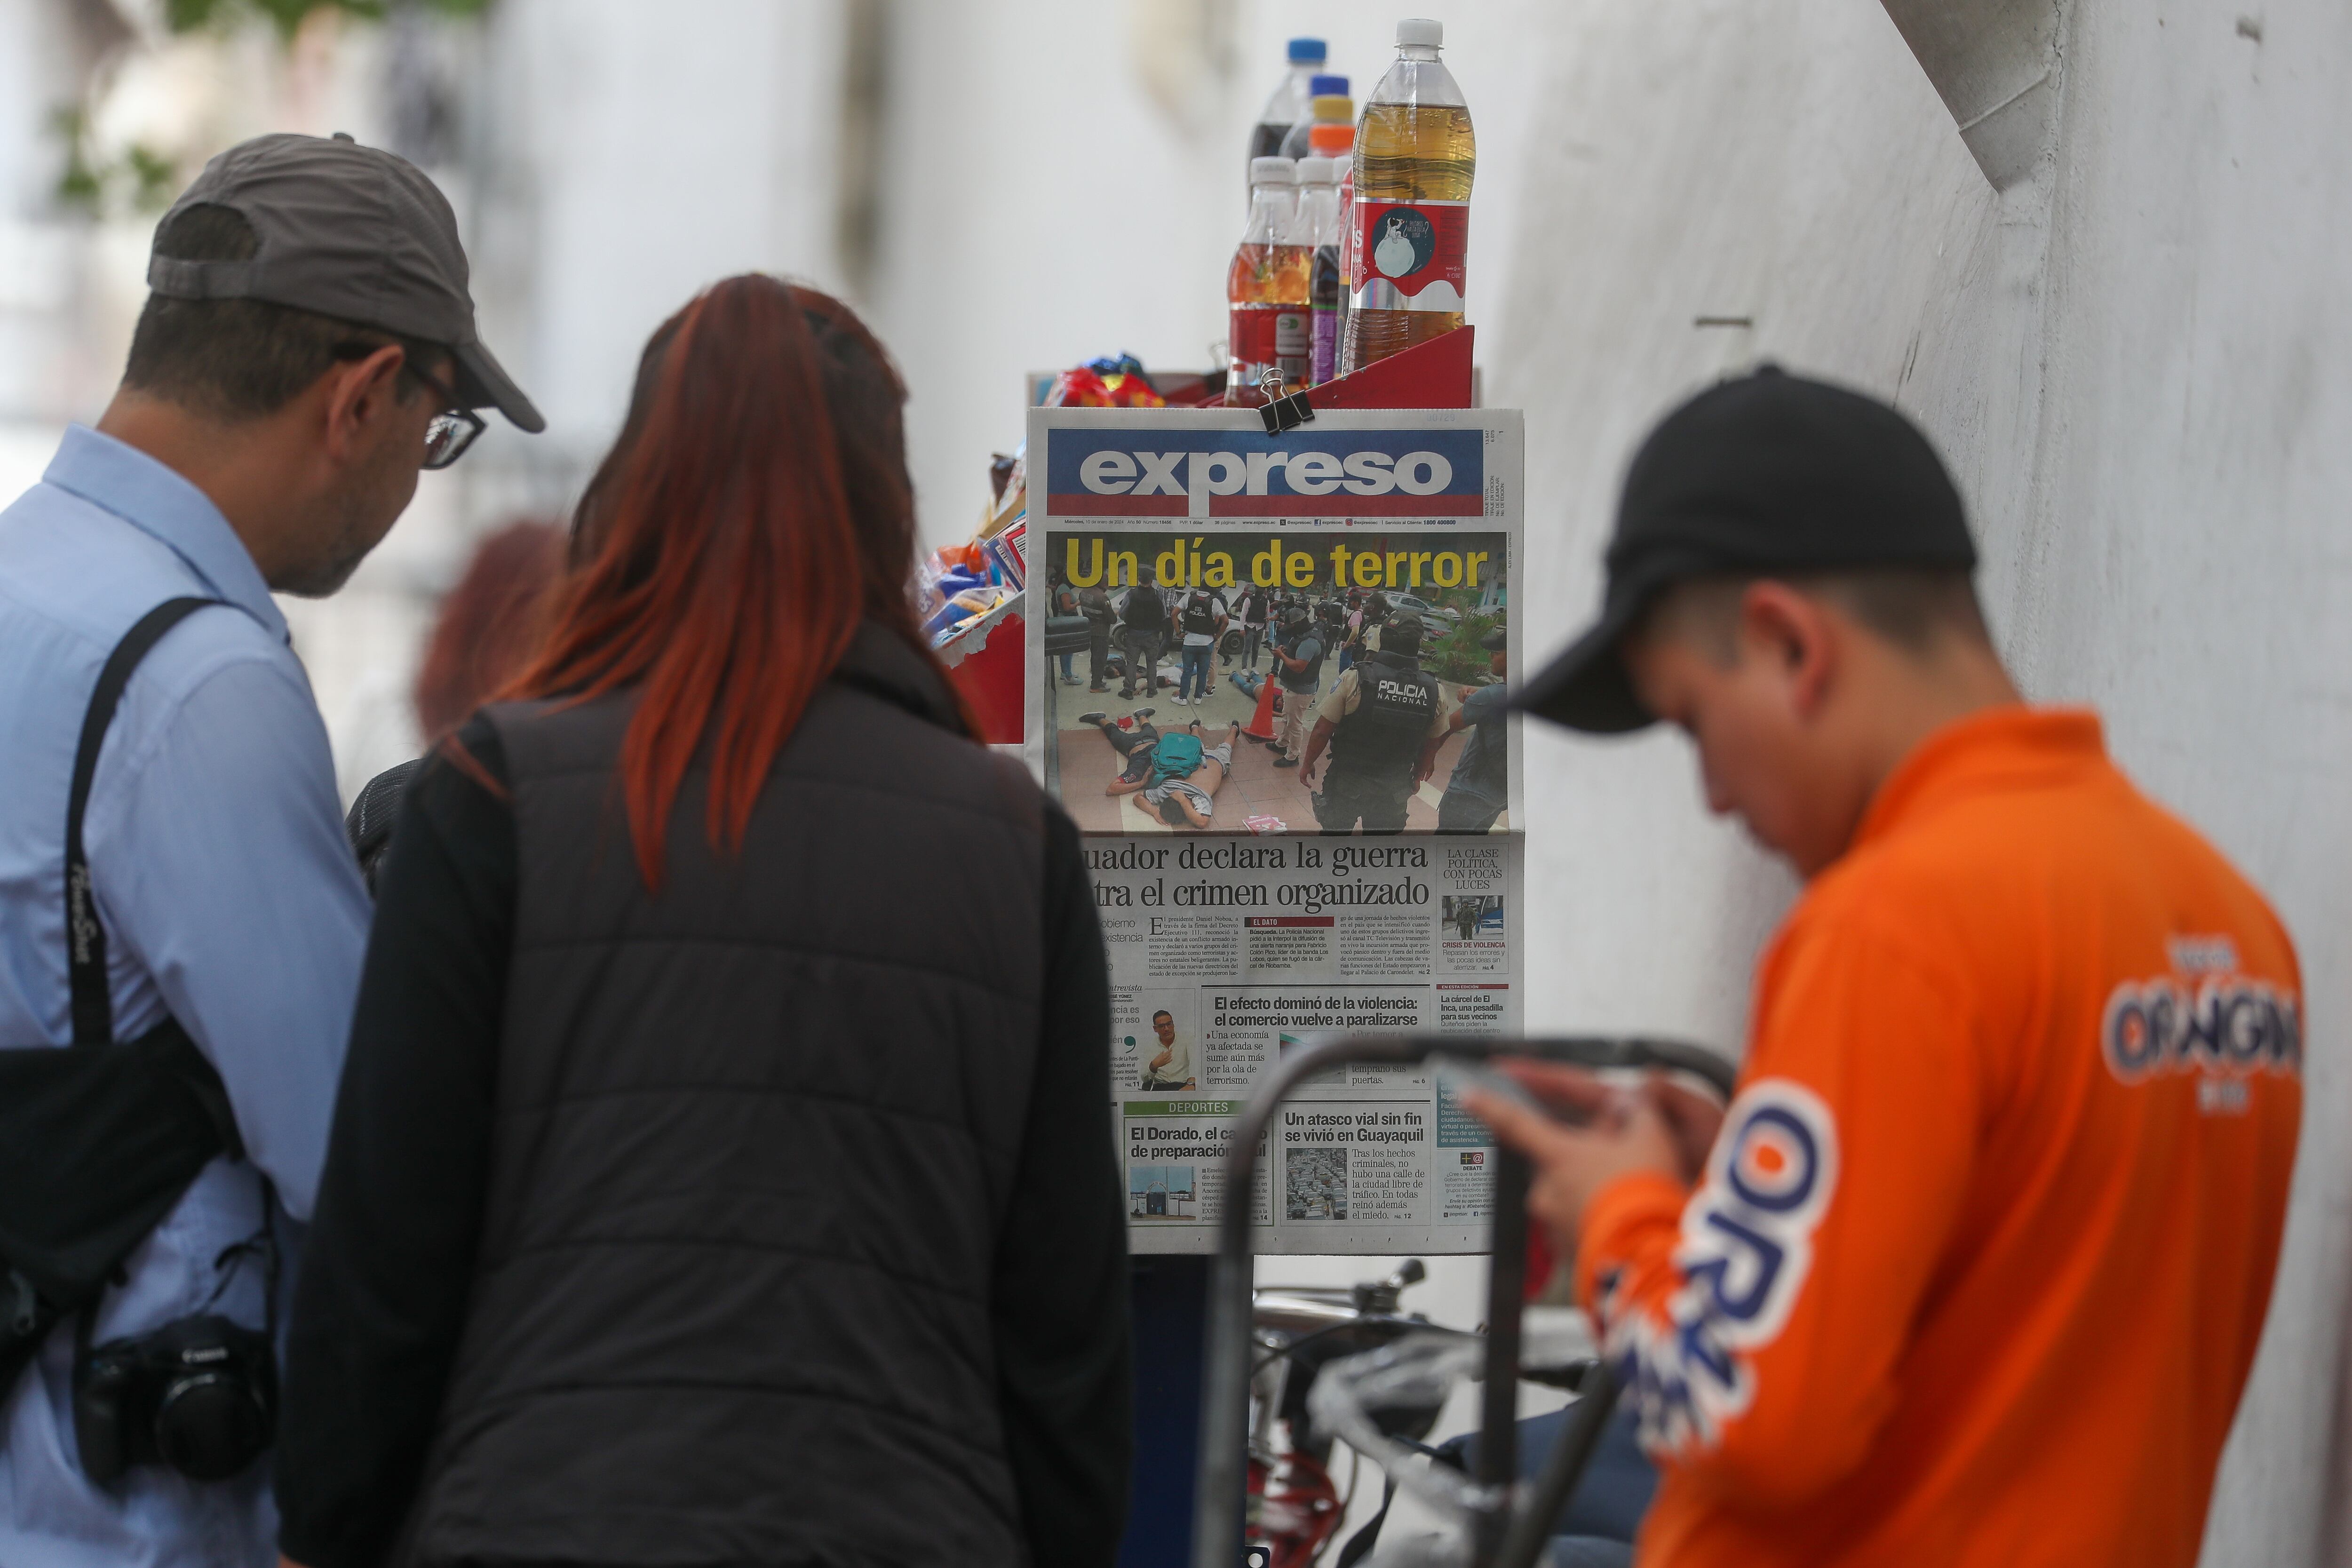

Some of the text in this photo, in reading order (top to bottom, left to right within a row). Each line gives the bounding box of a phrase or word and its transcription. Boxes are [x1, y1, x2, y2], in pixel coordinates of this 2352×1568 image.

[1080, 451, 1452, 516] expreso
[1066, 538, 1138, 588] Un
[1155, 537, 1236, 588] día
[1252, 539, 1314, 588] de
[1330, 544, 1488, 588] terror
[1378, 680, 1427, 700] POLICIA
[1377, 694, 1427, 706] NACIONAL
[1465, 849, 1499, 858] CLASE
[1083, 842, 1429, 877] uador declara la guerra
[1448, 856, 1498, 869] POLÍTICA,
[1443, 869, 1502, 879] CON POCAS
[1455, 880, 1490, 889] LUCES
[1095, 876, 1429, 914] tra el crimen organizado
[1101, 919, 1135, 928] obierno
[1215, 996, 1417, 1010] El efecto dominó de la violencia:
[1473, 1004, 1503, 1012] pesadilla
[1215, 1012, 1418, 1028] el comercio vuelve a paralizarse
[1211, 1030, 1269, 1039] Una economía
[1218, 1042, 1252, 1050] afectada
[1352, 1064, 1390, 1074] temprano
[1352, 1076, 1383, 1086] puertas.
[1169, 1102, 1228, 1112] DEPORTES
[1285, 1112, 1422, 1125] Un atasco vial sin fin
[1131, 1127, 1144, 1140] El
[1148, 1127, 1201, 1142] Dorado,
[1205, 1127, 1217, 1139] el
[1285, 1128, 1423, 1144] se vivió en Guayaquil
[1131, 1145, 1148, 1157] de
[1352, 1149, 1415, 1157] Tras los hechos
[1352, 1159, 1396, 1168] criminales,
[1352, 1170, 1373, 1178] hubo
[1362, 1180, 1390, 1188] ciudad
[1396, 1190, 1418, 1198] todas
[1362, 1210, 1389, 1219] miedo.
